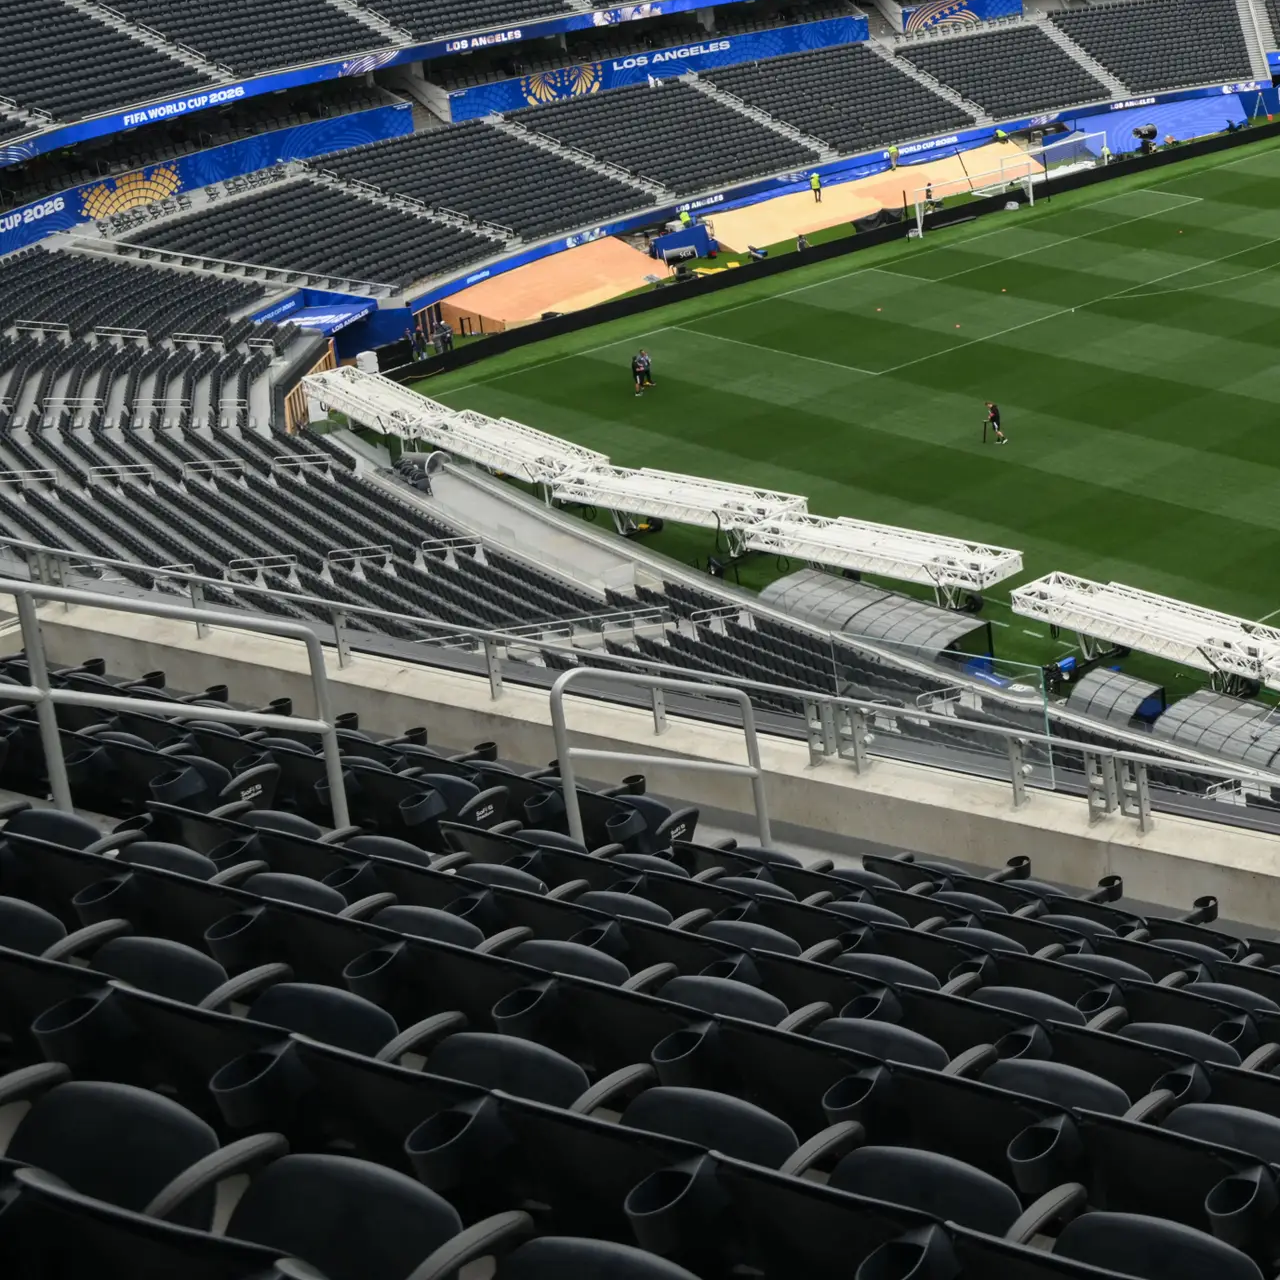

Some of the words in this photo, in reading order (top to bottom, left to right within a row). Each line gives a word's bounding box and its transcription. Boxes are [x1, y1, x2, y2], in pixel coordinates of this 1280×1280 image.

[446, 40, 468, 52] LOS
[471, 30, 523, 48] ANGELES
[613, 56, 650, 72] LOS
[652, 40, 731, 64] ANGELES
[123, 113, 148, 126] FIFA
[148, 101, 187, 121] WORLD
[187, 95, 208, 110] CUP
[209, 86, 245, 104] 2026
[1110, 102, 1123, 111] LOS
[1124, 98, 1156, 108] ANGELES
[24, 197, 66, 224] 2026
[332, 322, 344, 333] LOS
[343, 308, 369, 327] ANGELES
